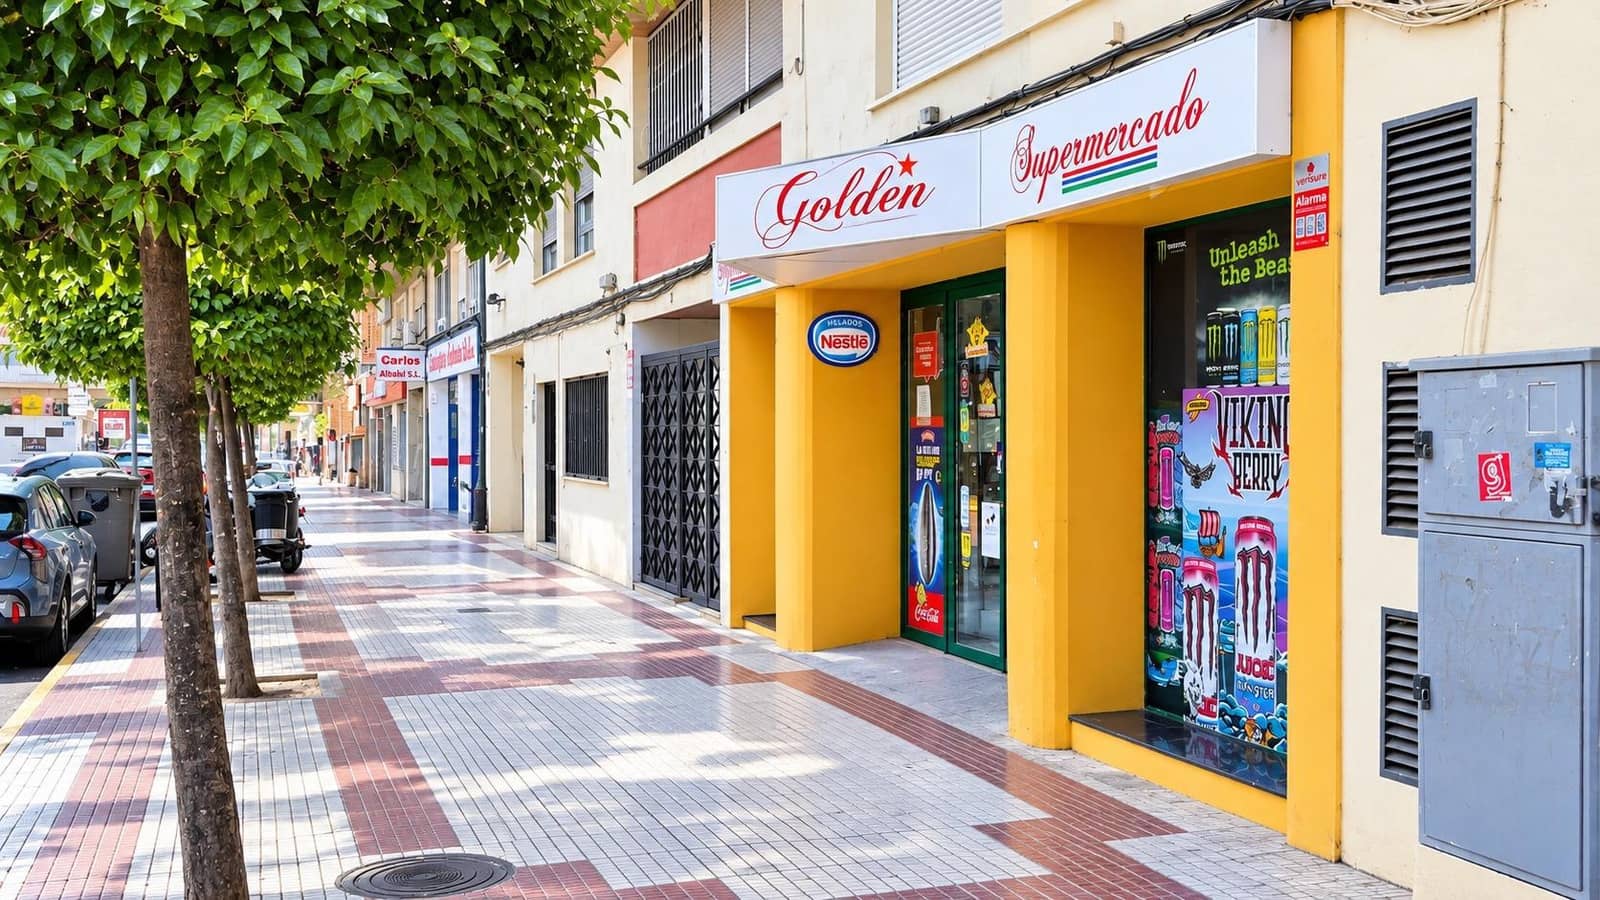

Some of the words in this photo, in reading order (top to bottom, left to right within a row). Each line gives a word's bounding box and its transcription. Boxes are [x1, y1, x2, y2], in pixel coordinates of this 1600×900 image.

[1009, 67, 1210, 204] Supermercado
[1295, 172, 1328, 187] verisure
[757, 158, 935, 248] Golden
[1295, 193, 1328, 208] Alarma
[1208, 228, 1280, 268] Unleash
[1219, 265, 1251, 288] the
[826, 318, 864, 328] HELADOS
[380, 355, 420, 366] Carlos
[1230, 452, 1283, 494] BERRY
